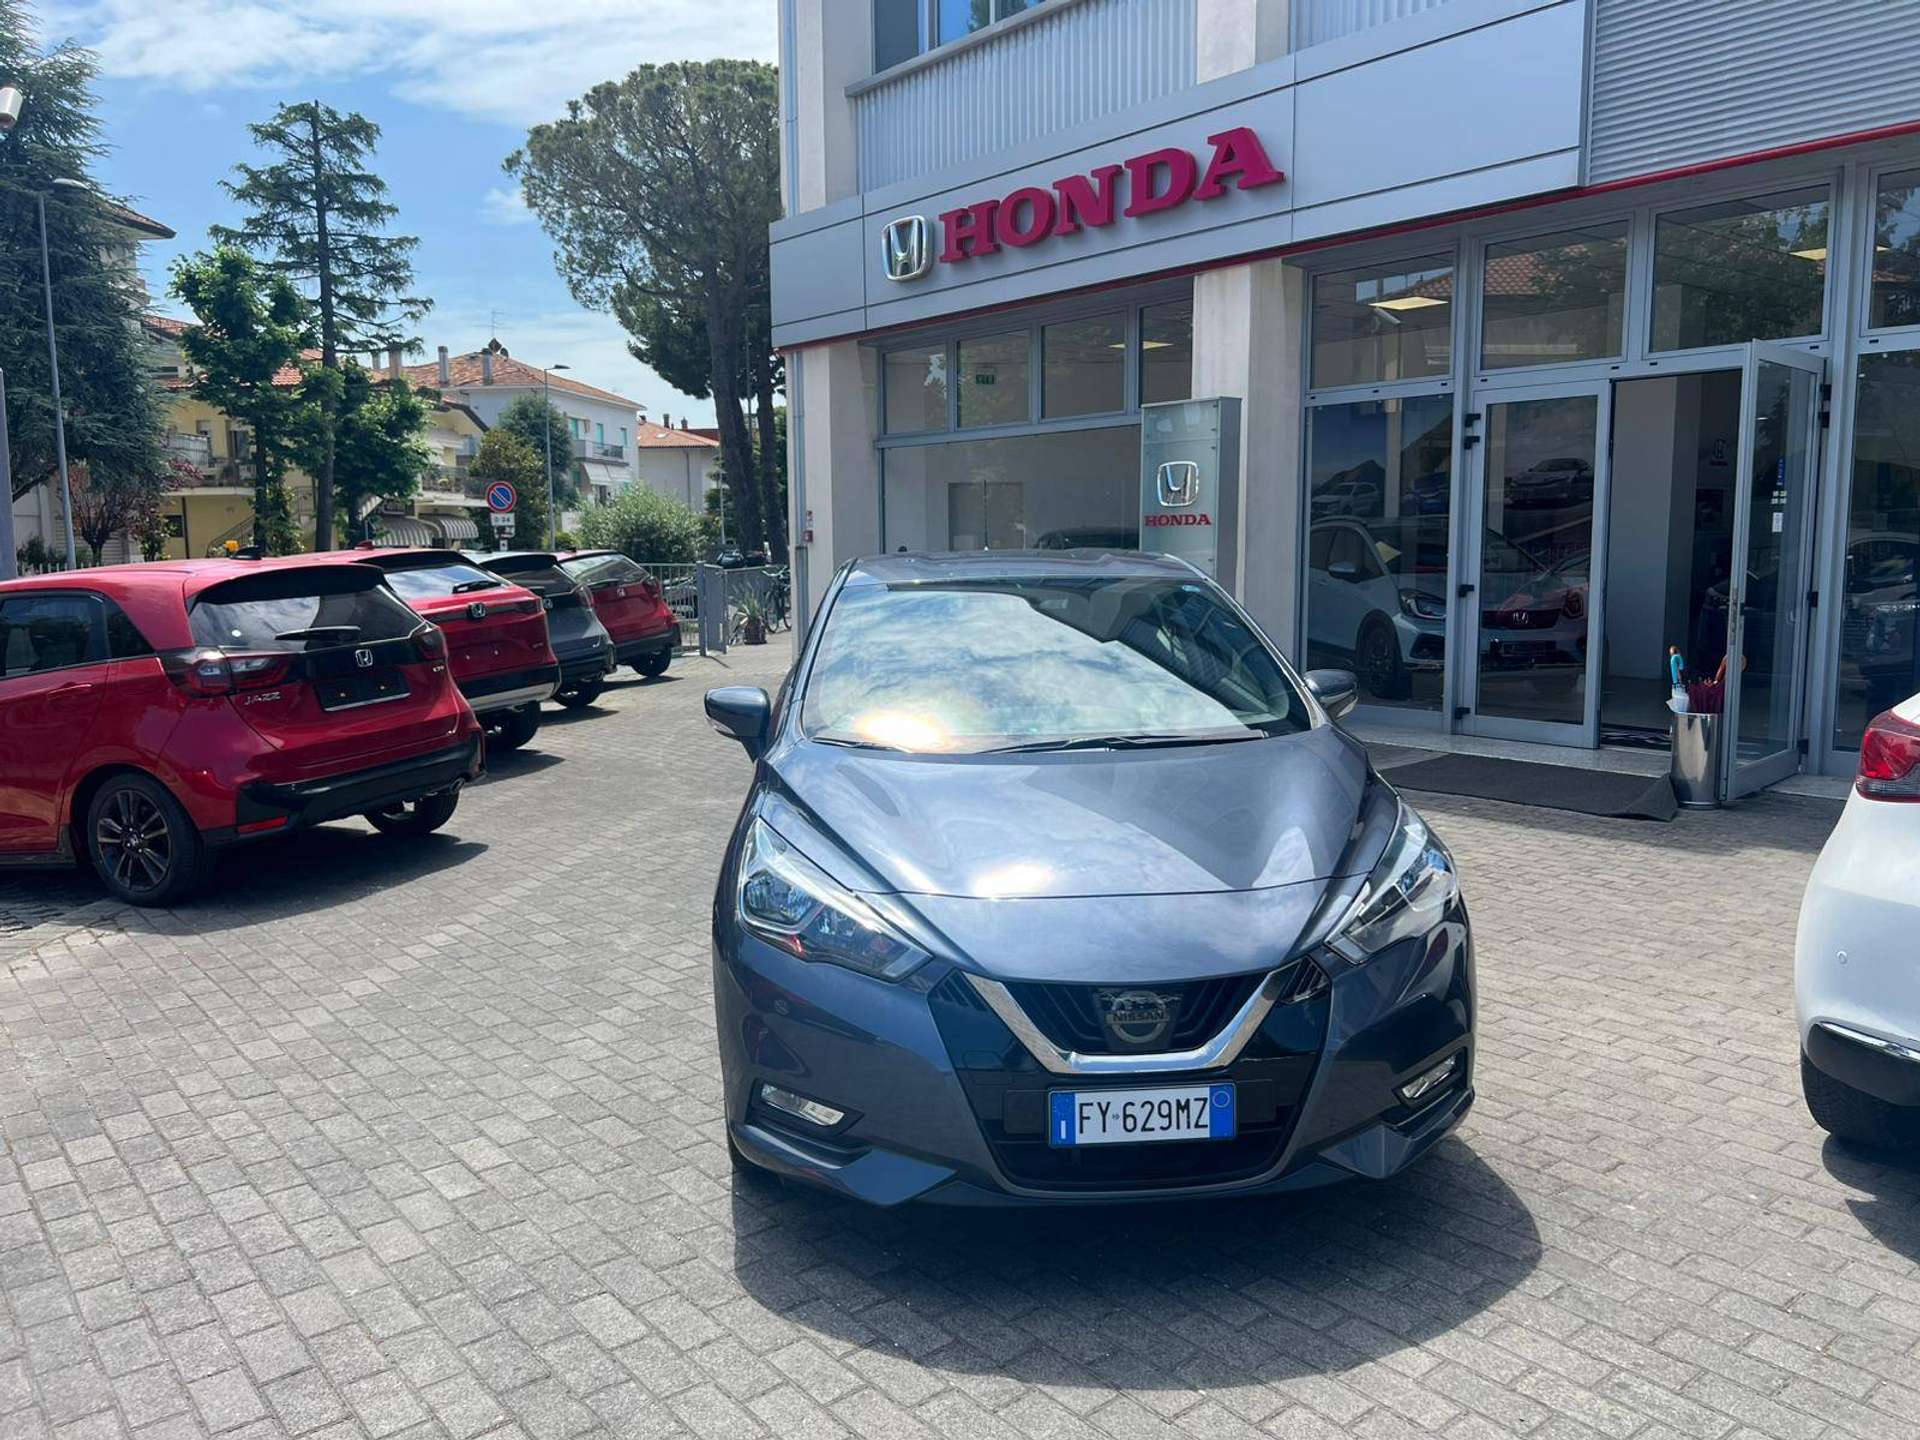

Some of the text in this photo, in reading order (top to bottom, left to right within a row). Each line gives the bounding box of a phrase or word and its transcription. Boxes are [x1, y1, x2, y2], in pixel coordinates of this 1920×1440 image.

[939, 127, 1285, 263] HONDA
[1144, 513, 1212, 527] HONDA
[1112, 1009, 1165, 1022] NISSAN
